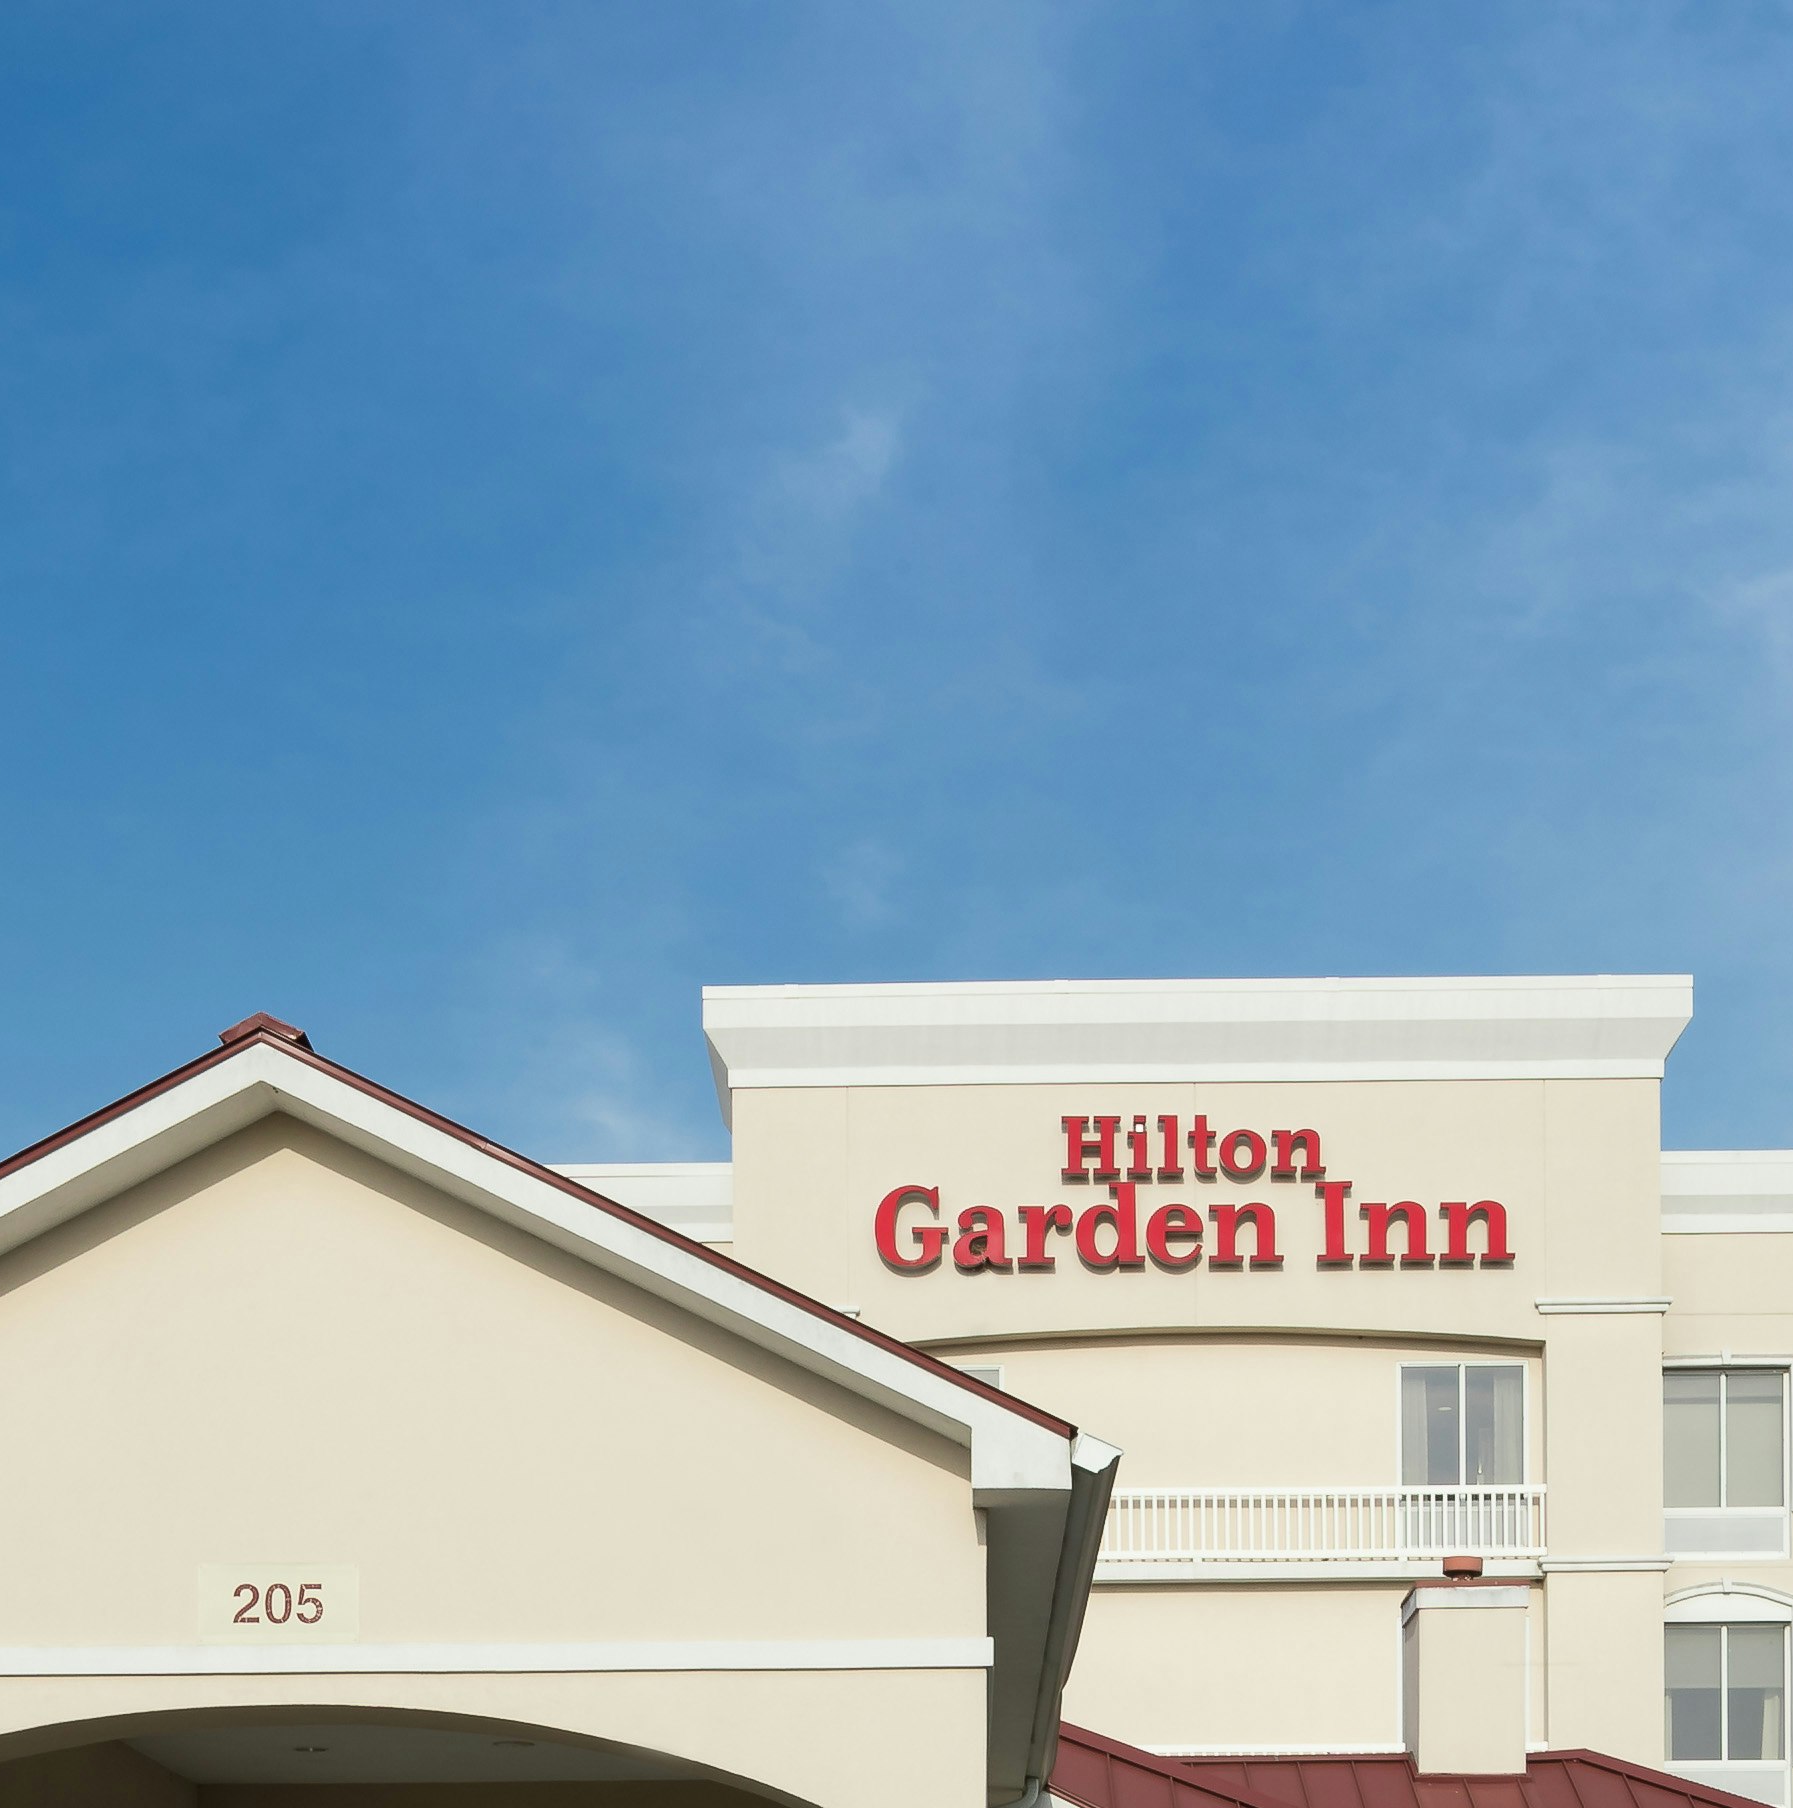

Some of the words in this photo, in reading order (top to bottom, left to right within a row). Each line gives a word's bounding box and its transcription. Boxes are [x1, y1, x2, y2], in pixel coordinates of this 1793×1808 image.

[1061, 1115, 1326, 1177] Hilton
[874, 1181, 1284, 1269] Garden
[1315, 1181, 1516, 1264] Inn
[233, 1583, 324, 1624] 205
